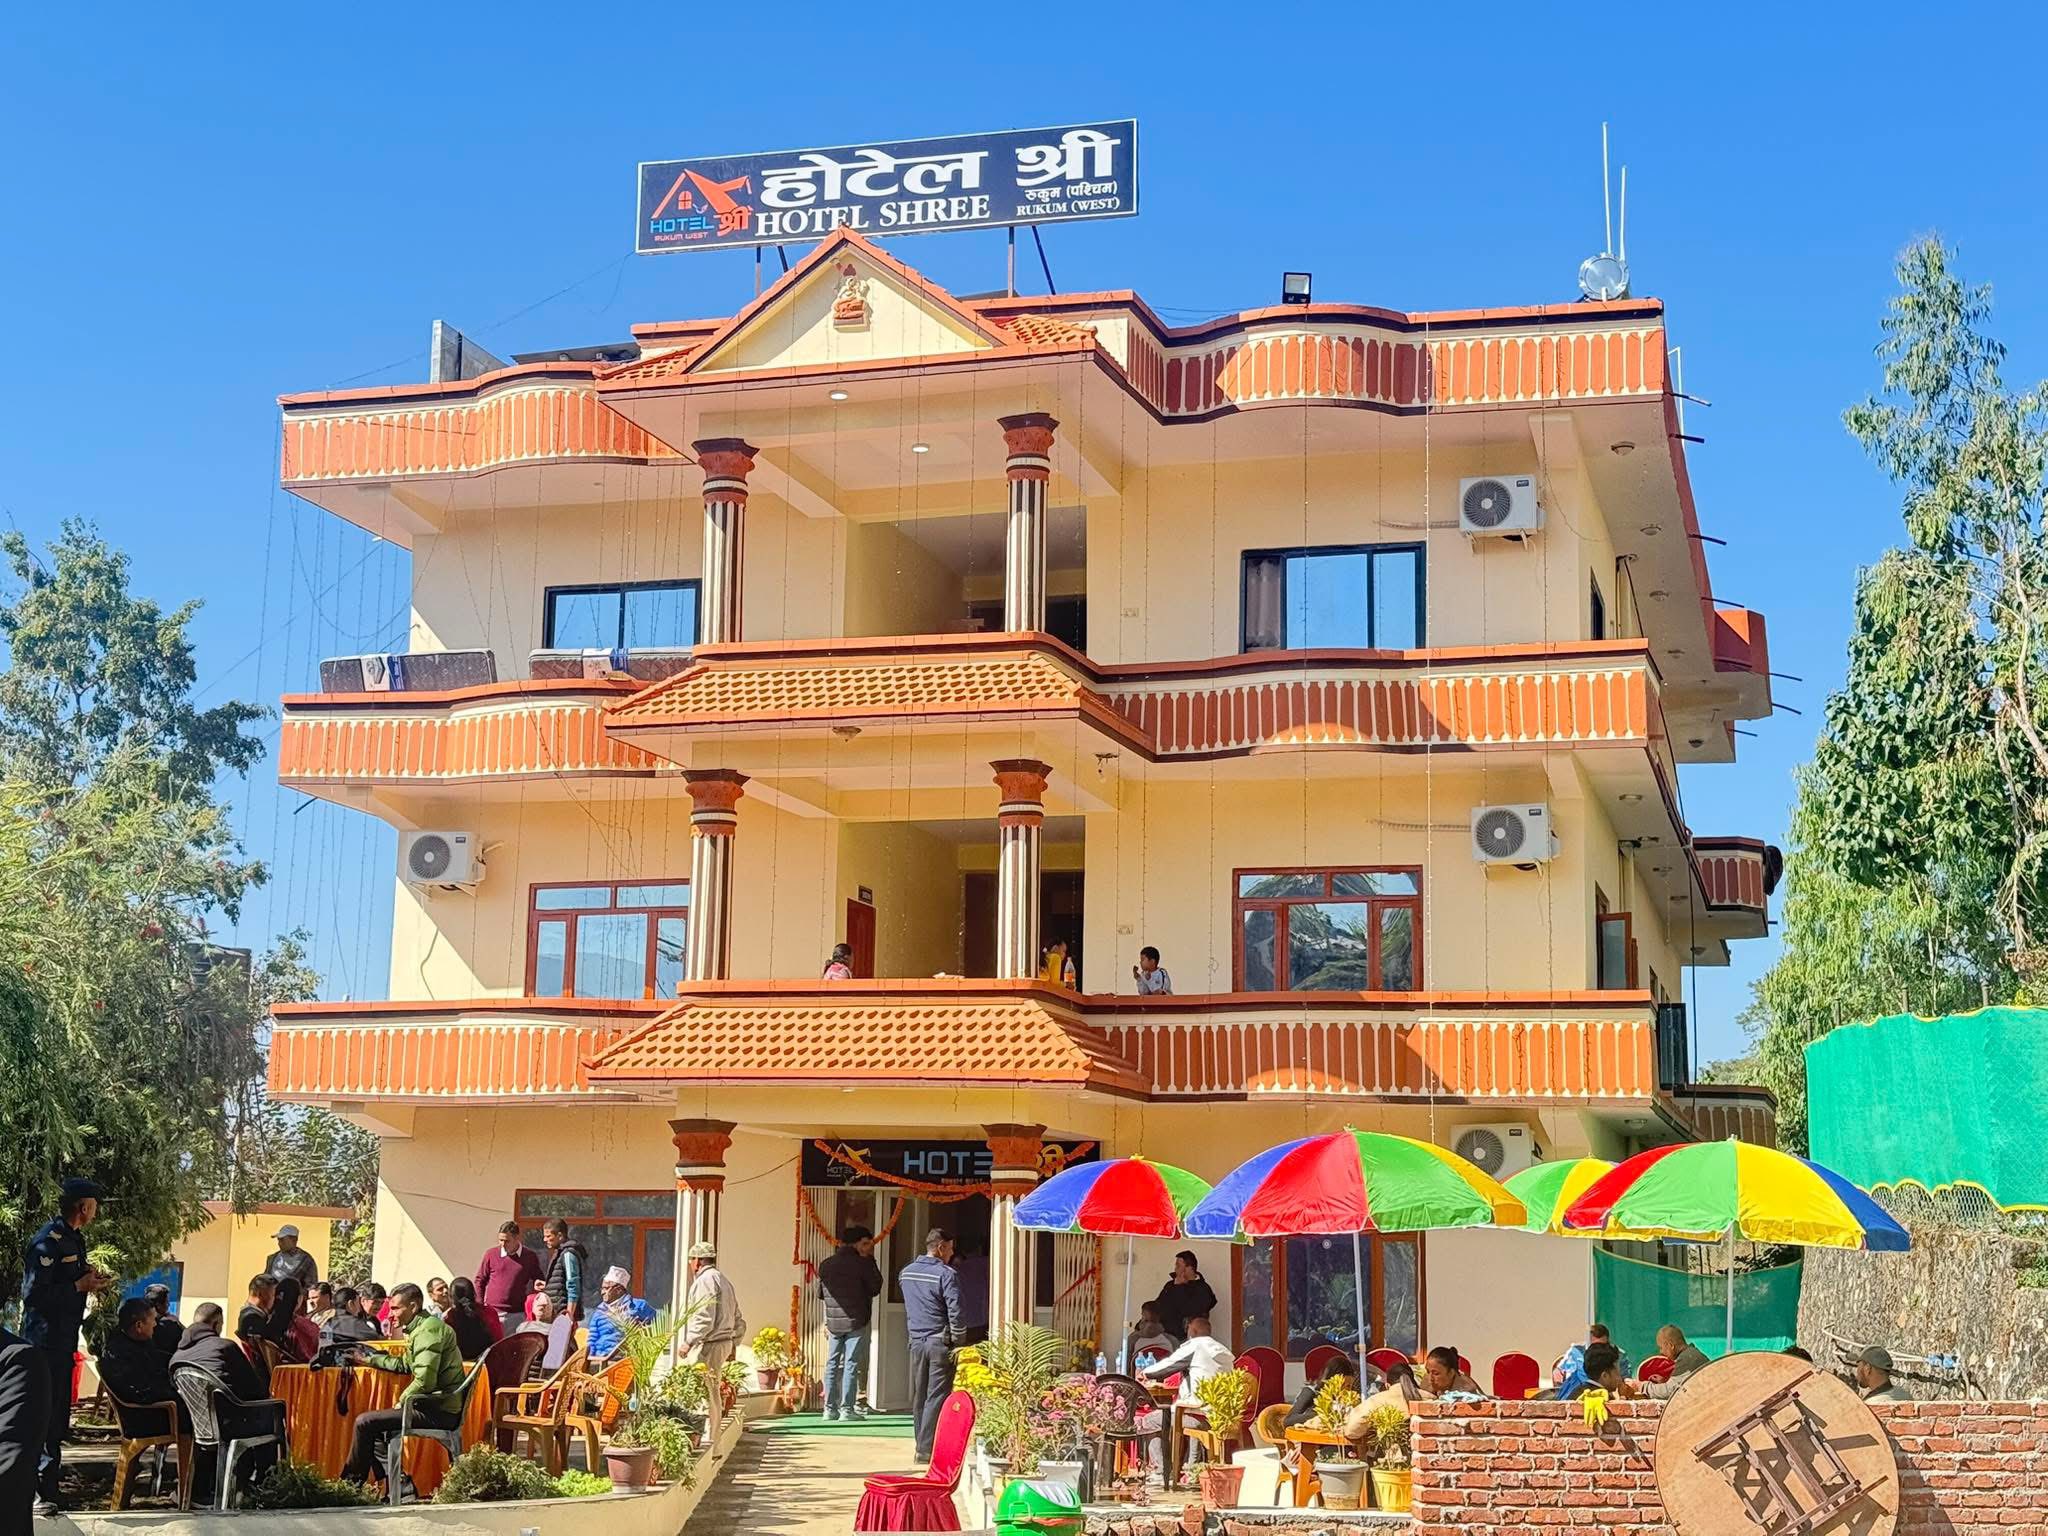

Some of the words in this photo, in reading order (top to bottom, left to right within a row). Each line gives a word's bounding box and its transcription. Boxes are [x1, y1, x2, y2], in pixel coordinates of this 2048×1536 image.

[760, 149, 988, 208] होटेल
[1015, 129, 1121, 187] श्री
[755, 205, 869, 237] HOTEL
[879, 194, 991, 228] SHREE
[1016, 202, 1068, 216] RUKUM
[1071, 197, 1120, 213] (WEST)
[650, 216, 715, 233] HOTEL
[713, 206, 753, 237] श्री
[654, 233, 683, 242] RUKUM
[685, 231, 709, 240] WEST
[904, 1151, 993, 1175] HOTE
